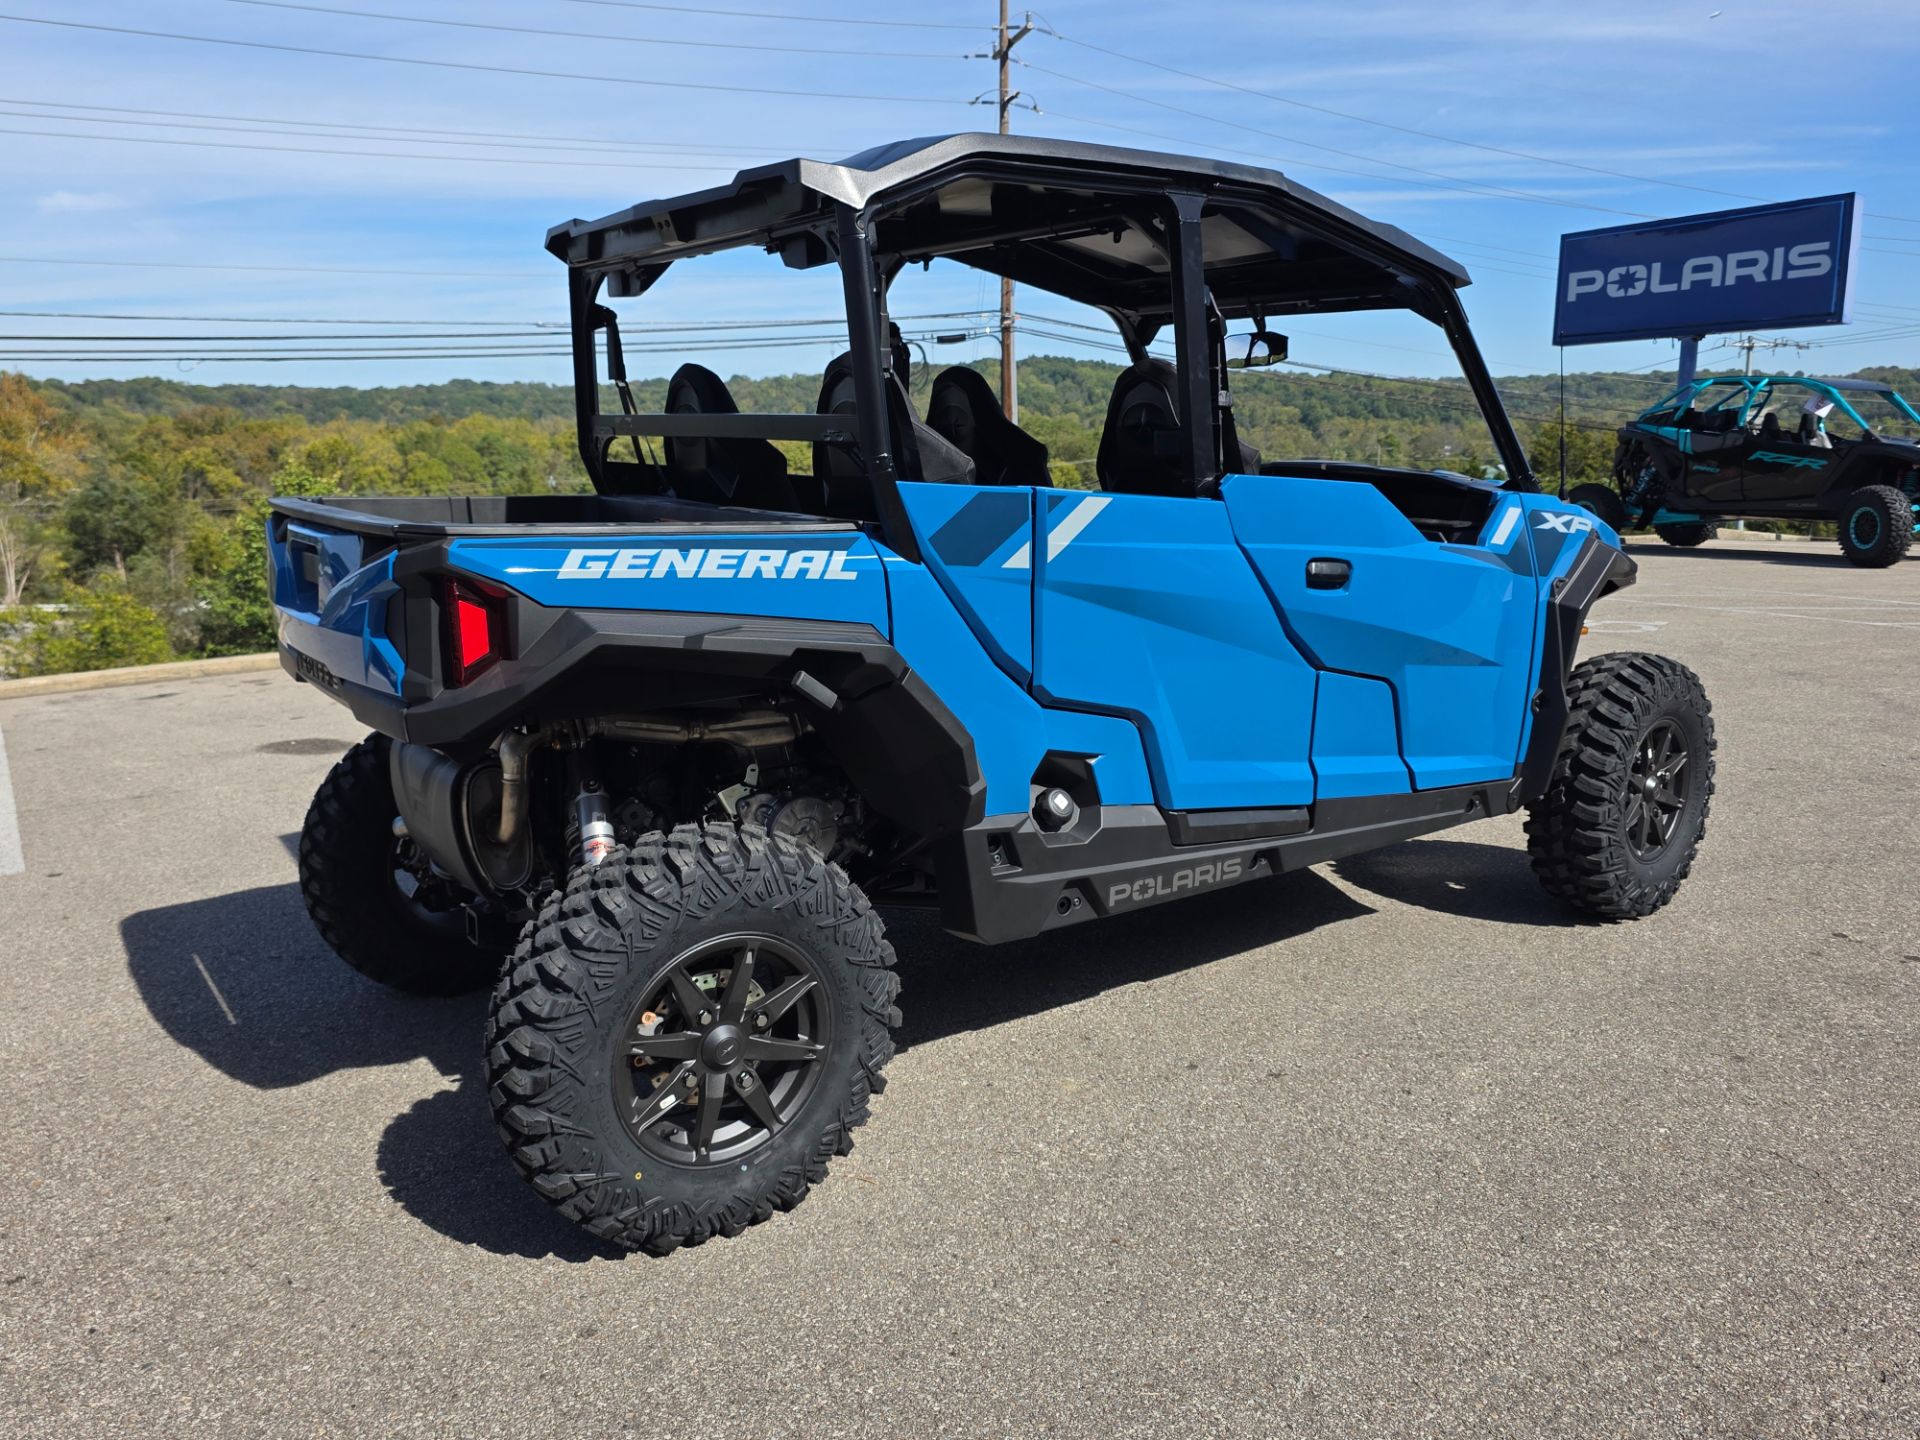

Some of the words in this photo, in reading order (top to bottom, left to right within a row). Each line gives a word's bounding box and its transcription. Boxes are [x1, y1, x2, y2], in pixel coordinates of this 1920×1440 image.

[1567, 241, 1832, 302] POLARIS
[1747, 450, 1829, 470] RZR
[1534, 511, 1592, 533] XP
[556, 549, 858, 581] GENERAL
[1108, 857, 1242, 907] POLARIS
